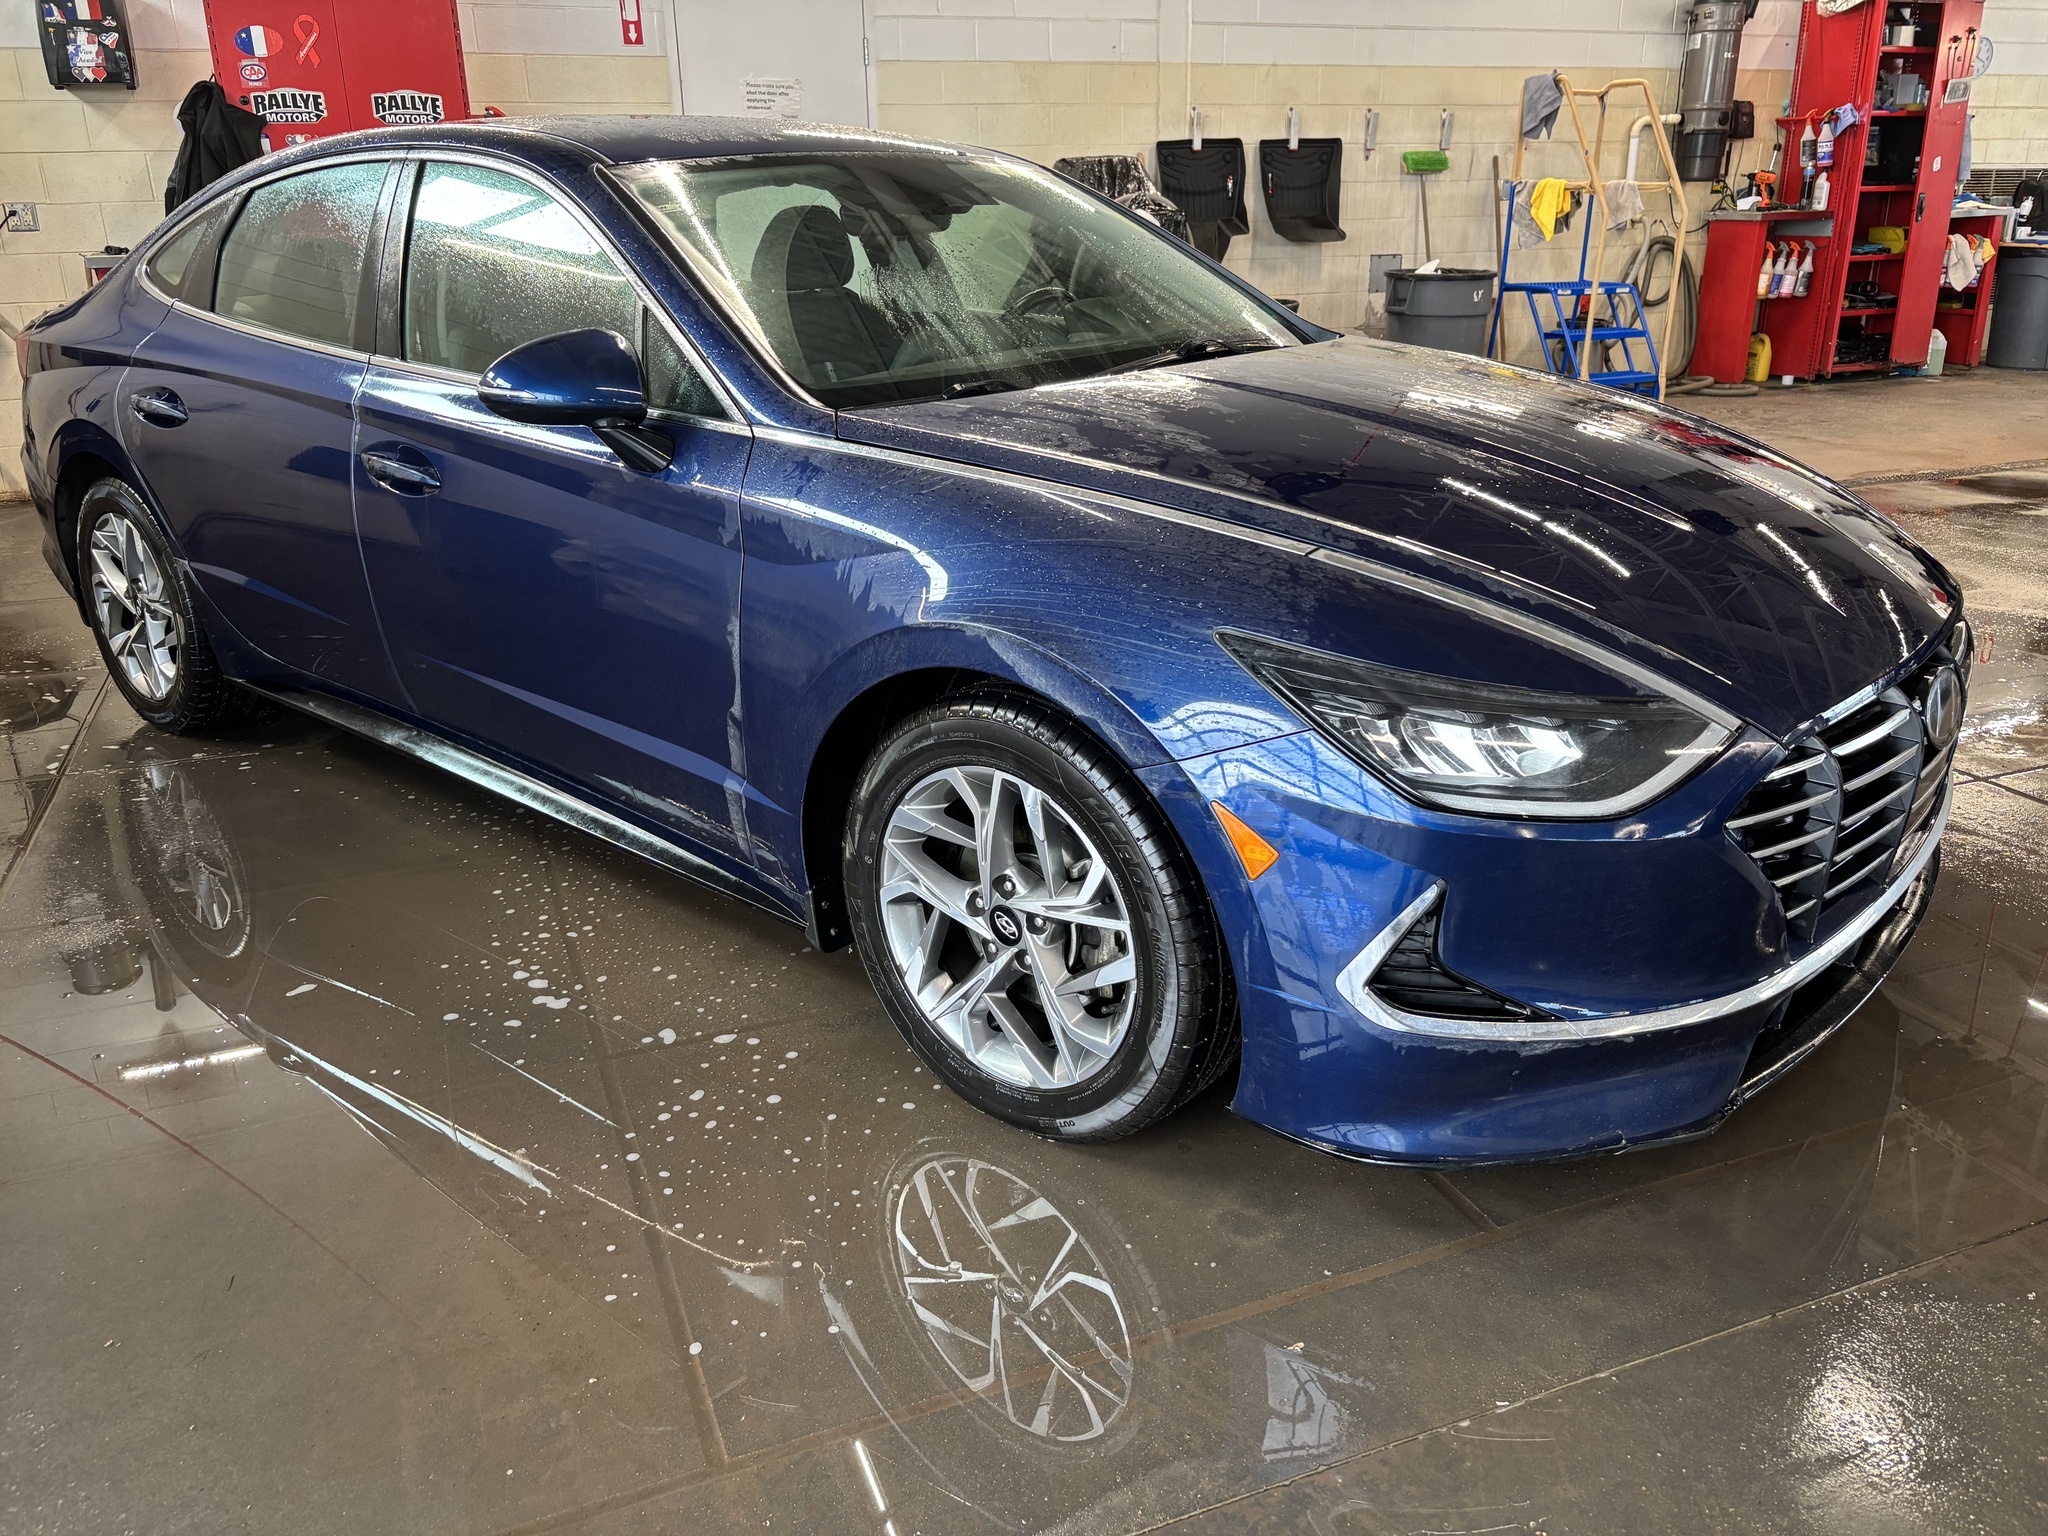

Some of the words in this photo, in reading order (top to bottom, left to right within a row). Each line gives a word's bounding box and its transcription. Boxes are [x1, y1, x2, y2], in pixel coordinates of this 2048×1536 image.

[243, 66, 264, 79] CAA
[252, 92, 325, 115] RALLYE
[373, 94, 442, 117] RALLYE
[266, 113, 318, 122] MOTORS
[385, 114, 435, 124] MOTORS
[1039, 1119, 1076, 1128] OUTSIDE
